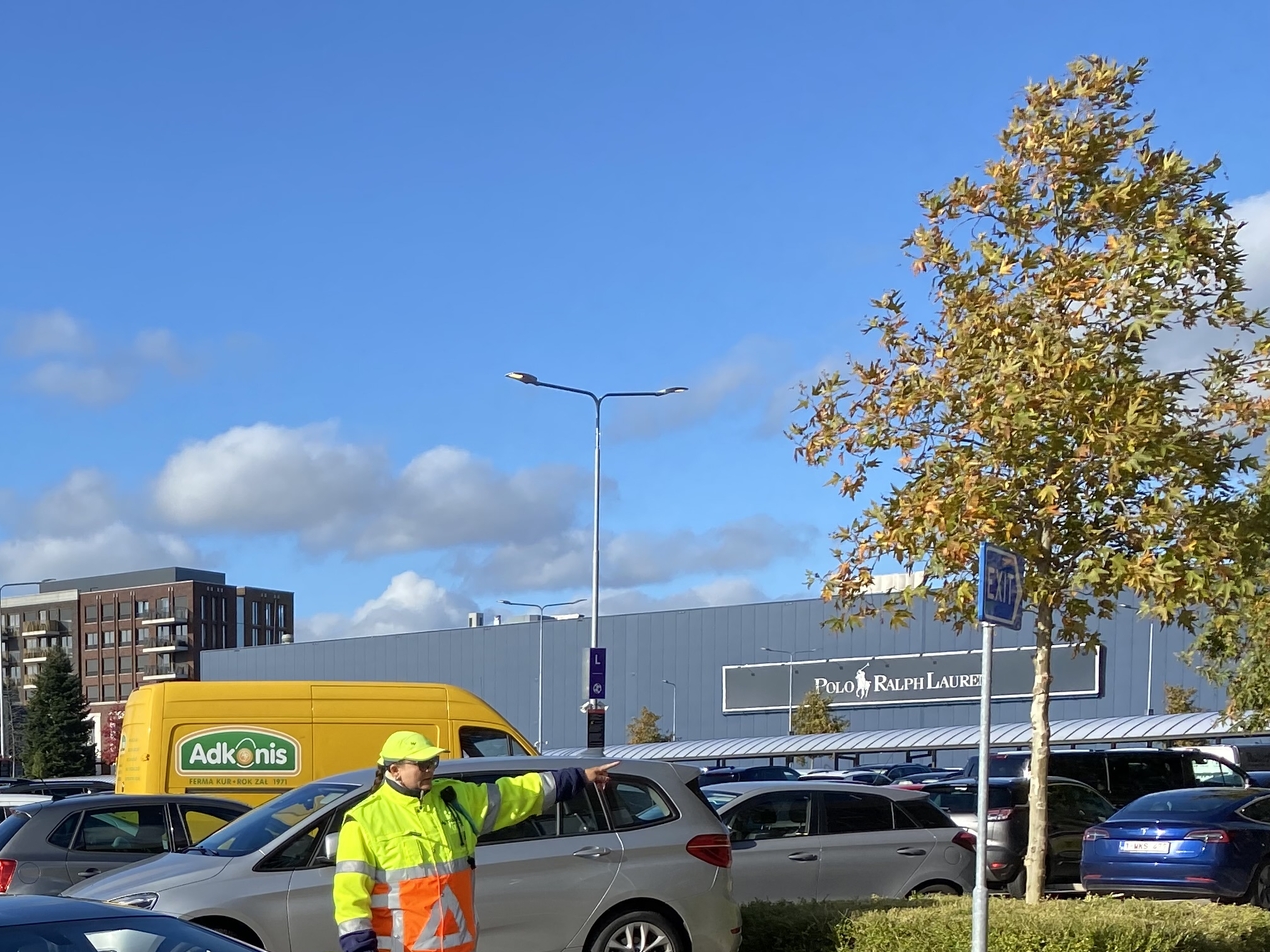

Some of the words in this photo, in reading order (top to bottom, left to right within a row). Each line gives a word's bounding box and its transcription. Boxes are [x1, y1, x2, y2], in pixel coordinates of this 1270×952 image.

[986, 566, 1015, 605] EXIT
[594, 653, 601, 665] L
[814, 677, 855, 695] POLO
[873, 674, 925, 692] RALPH
[926, 671, 983, 690] LAURE
[189, 738, 288, 768] Adkonis
